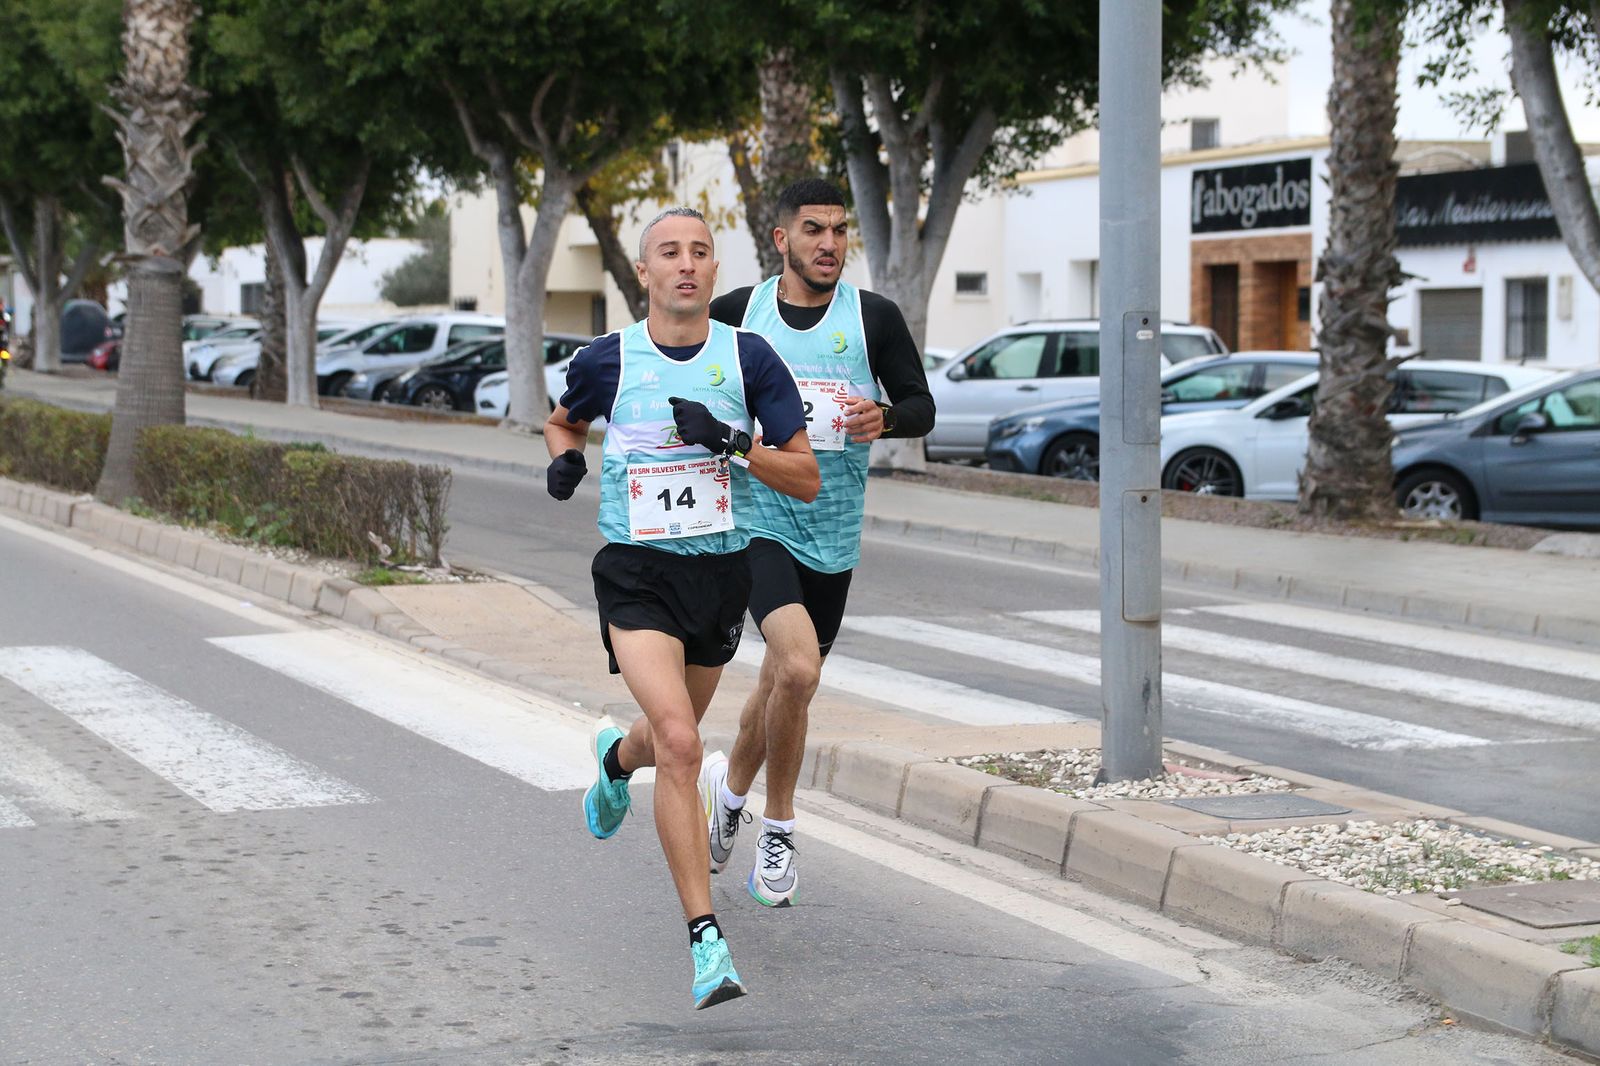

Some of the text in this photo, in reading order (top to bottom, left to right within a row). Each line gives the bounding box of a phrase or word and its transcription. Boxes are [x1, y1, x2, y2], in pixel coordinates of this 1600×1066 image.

[804, 401, 814, 422] 2
[638, 467, 650, 475] SAN
[651, 464, 687, 474] SILVESTRE
[688, 461, 710, 469] COMARCA
[657, 486, 696, 511] 14
